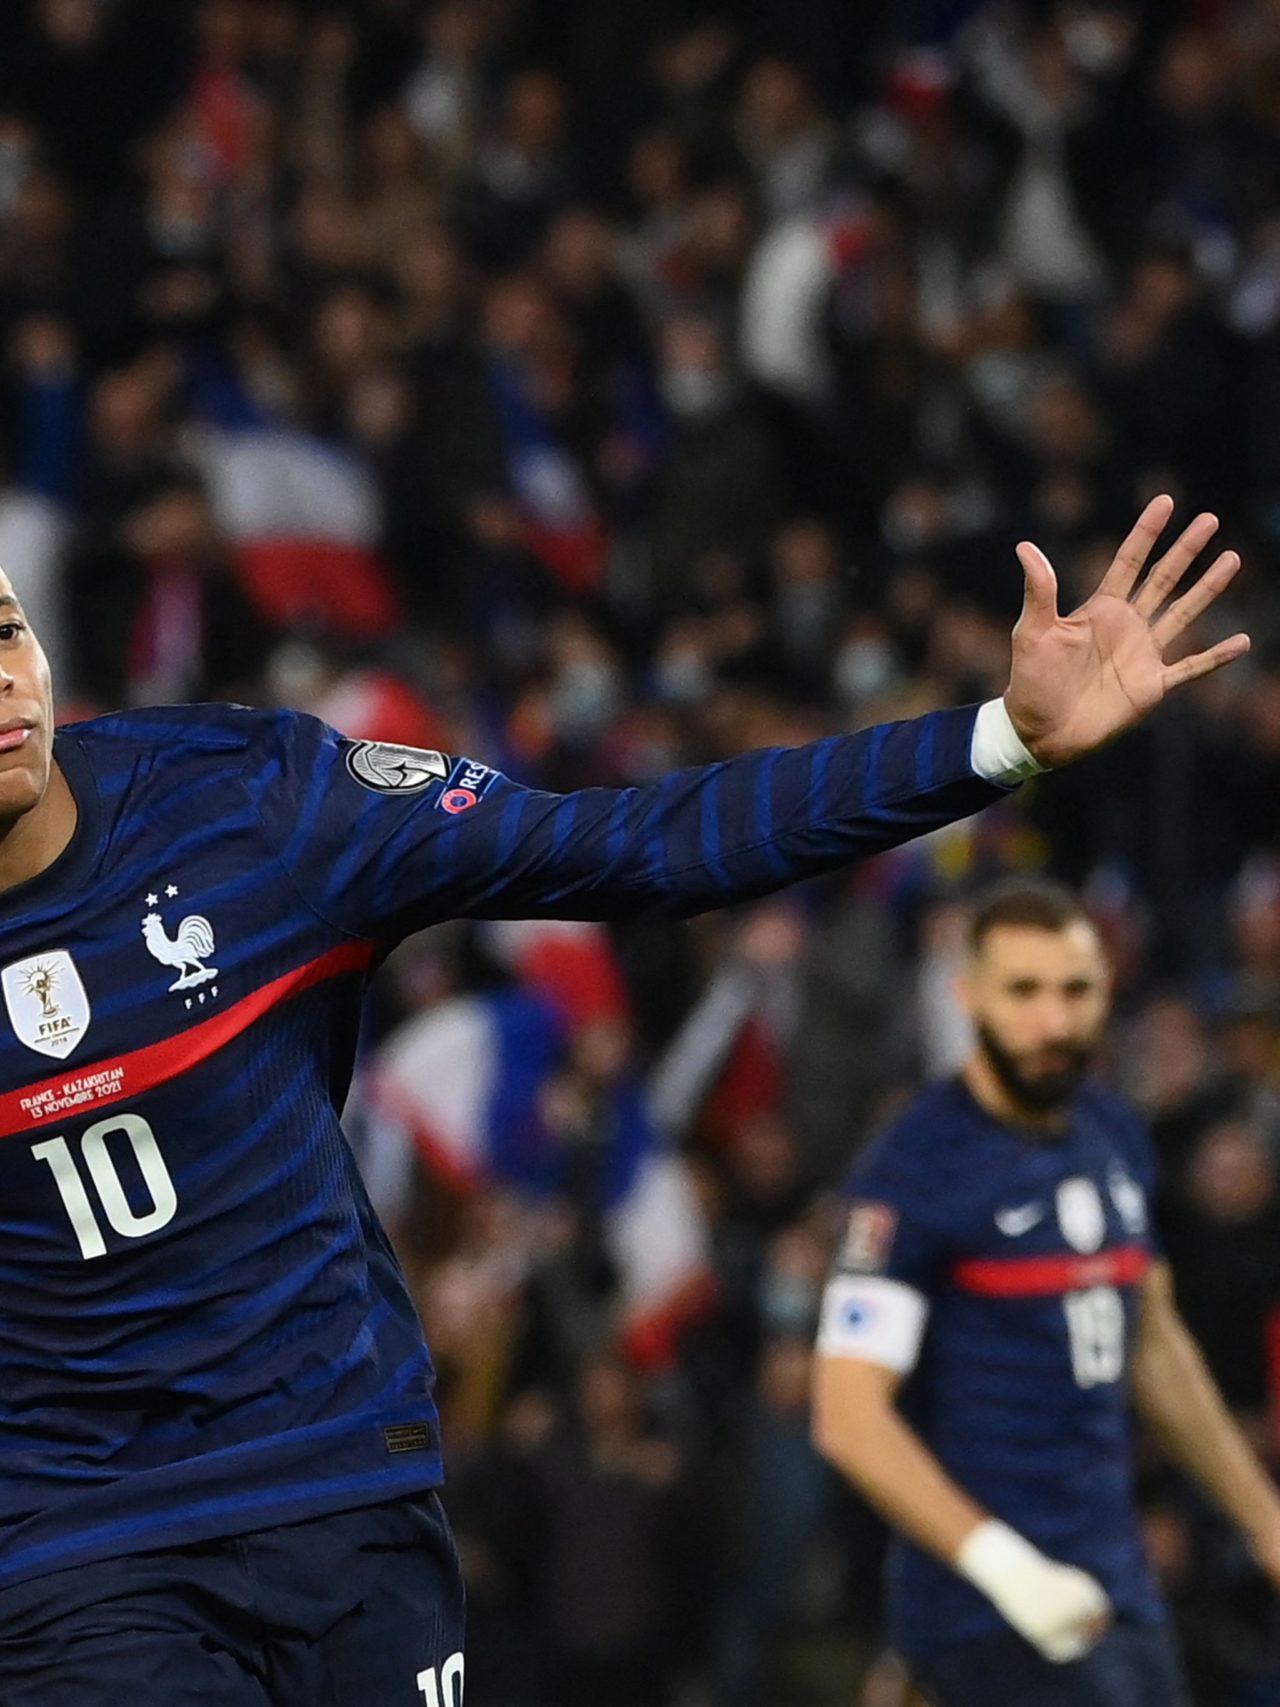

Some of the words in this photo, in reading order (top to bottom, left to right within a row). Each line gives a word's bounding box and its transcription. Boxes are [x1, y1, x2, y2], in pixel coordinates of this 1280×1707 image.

[39, 1017, 70, 1036] FIFA
[20, 1089, 55, 1111] FRANCE
[63, 1066, 124, 1096] KAZAKHSTAN
[30, 1104, 43, 1119] 13
[44, 1089, 94, 1114] NOVEMBRE
[95, 1080, 122, 1098] 2021
[30, 1113, 178, 1260] 10
[416, 1651, 464, 1707] 10
